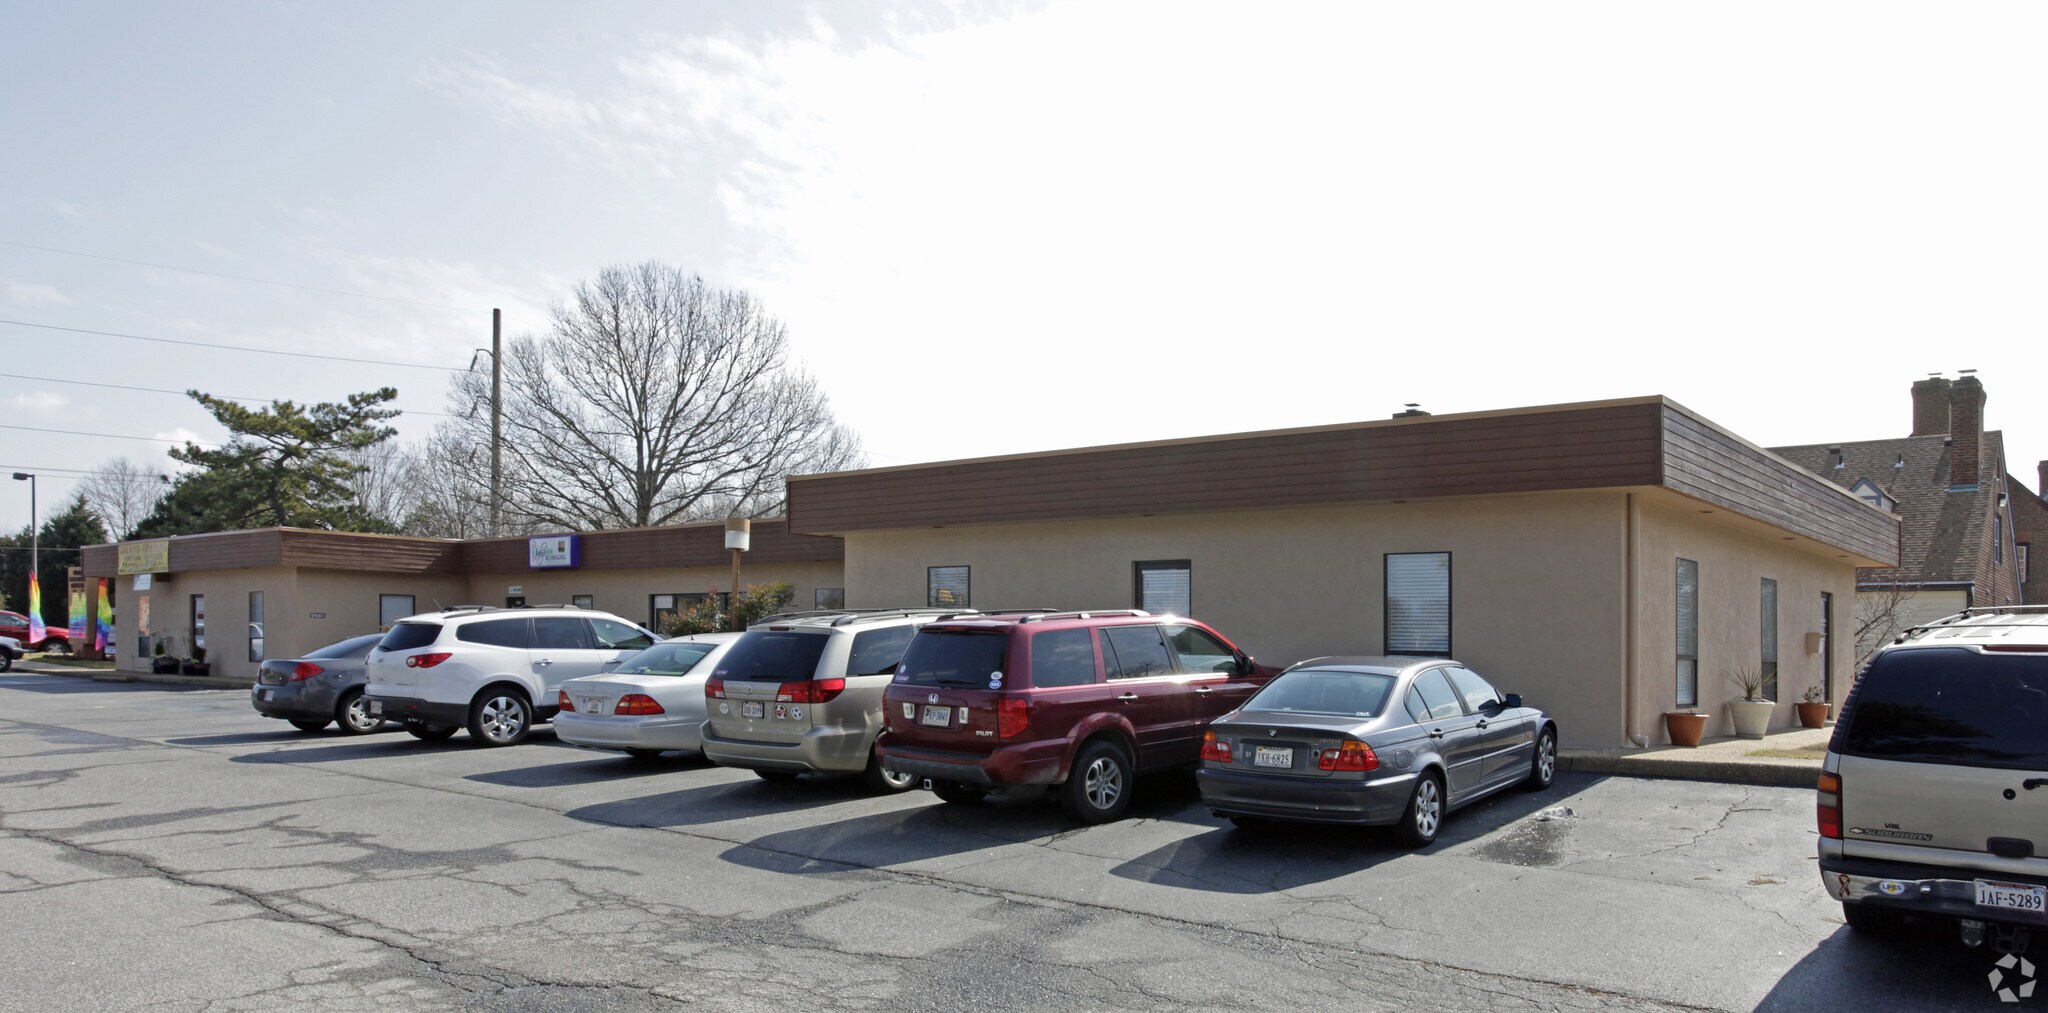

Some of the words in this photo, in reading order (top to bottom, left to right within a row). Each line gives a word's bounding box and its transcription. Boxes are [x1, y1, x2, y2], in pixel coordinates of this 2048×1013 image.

[1257, 752, 1289, 764] YKH-6825
[1863, 828, 1933, 841] SUBURBAN
[1882, 883, 1902, 891] LPES
[1979, 889, 2042, 910] JAF-5289
